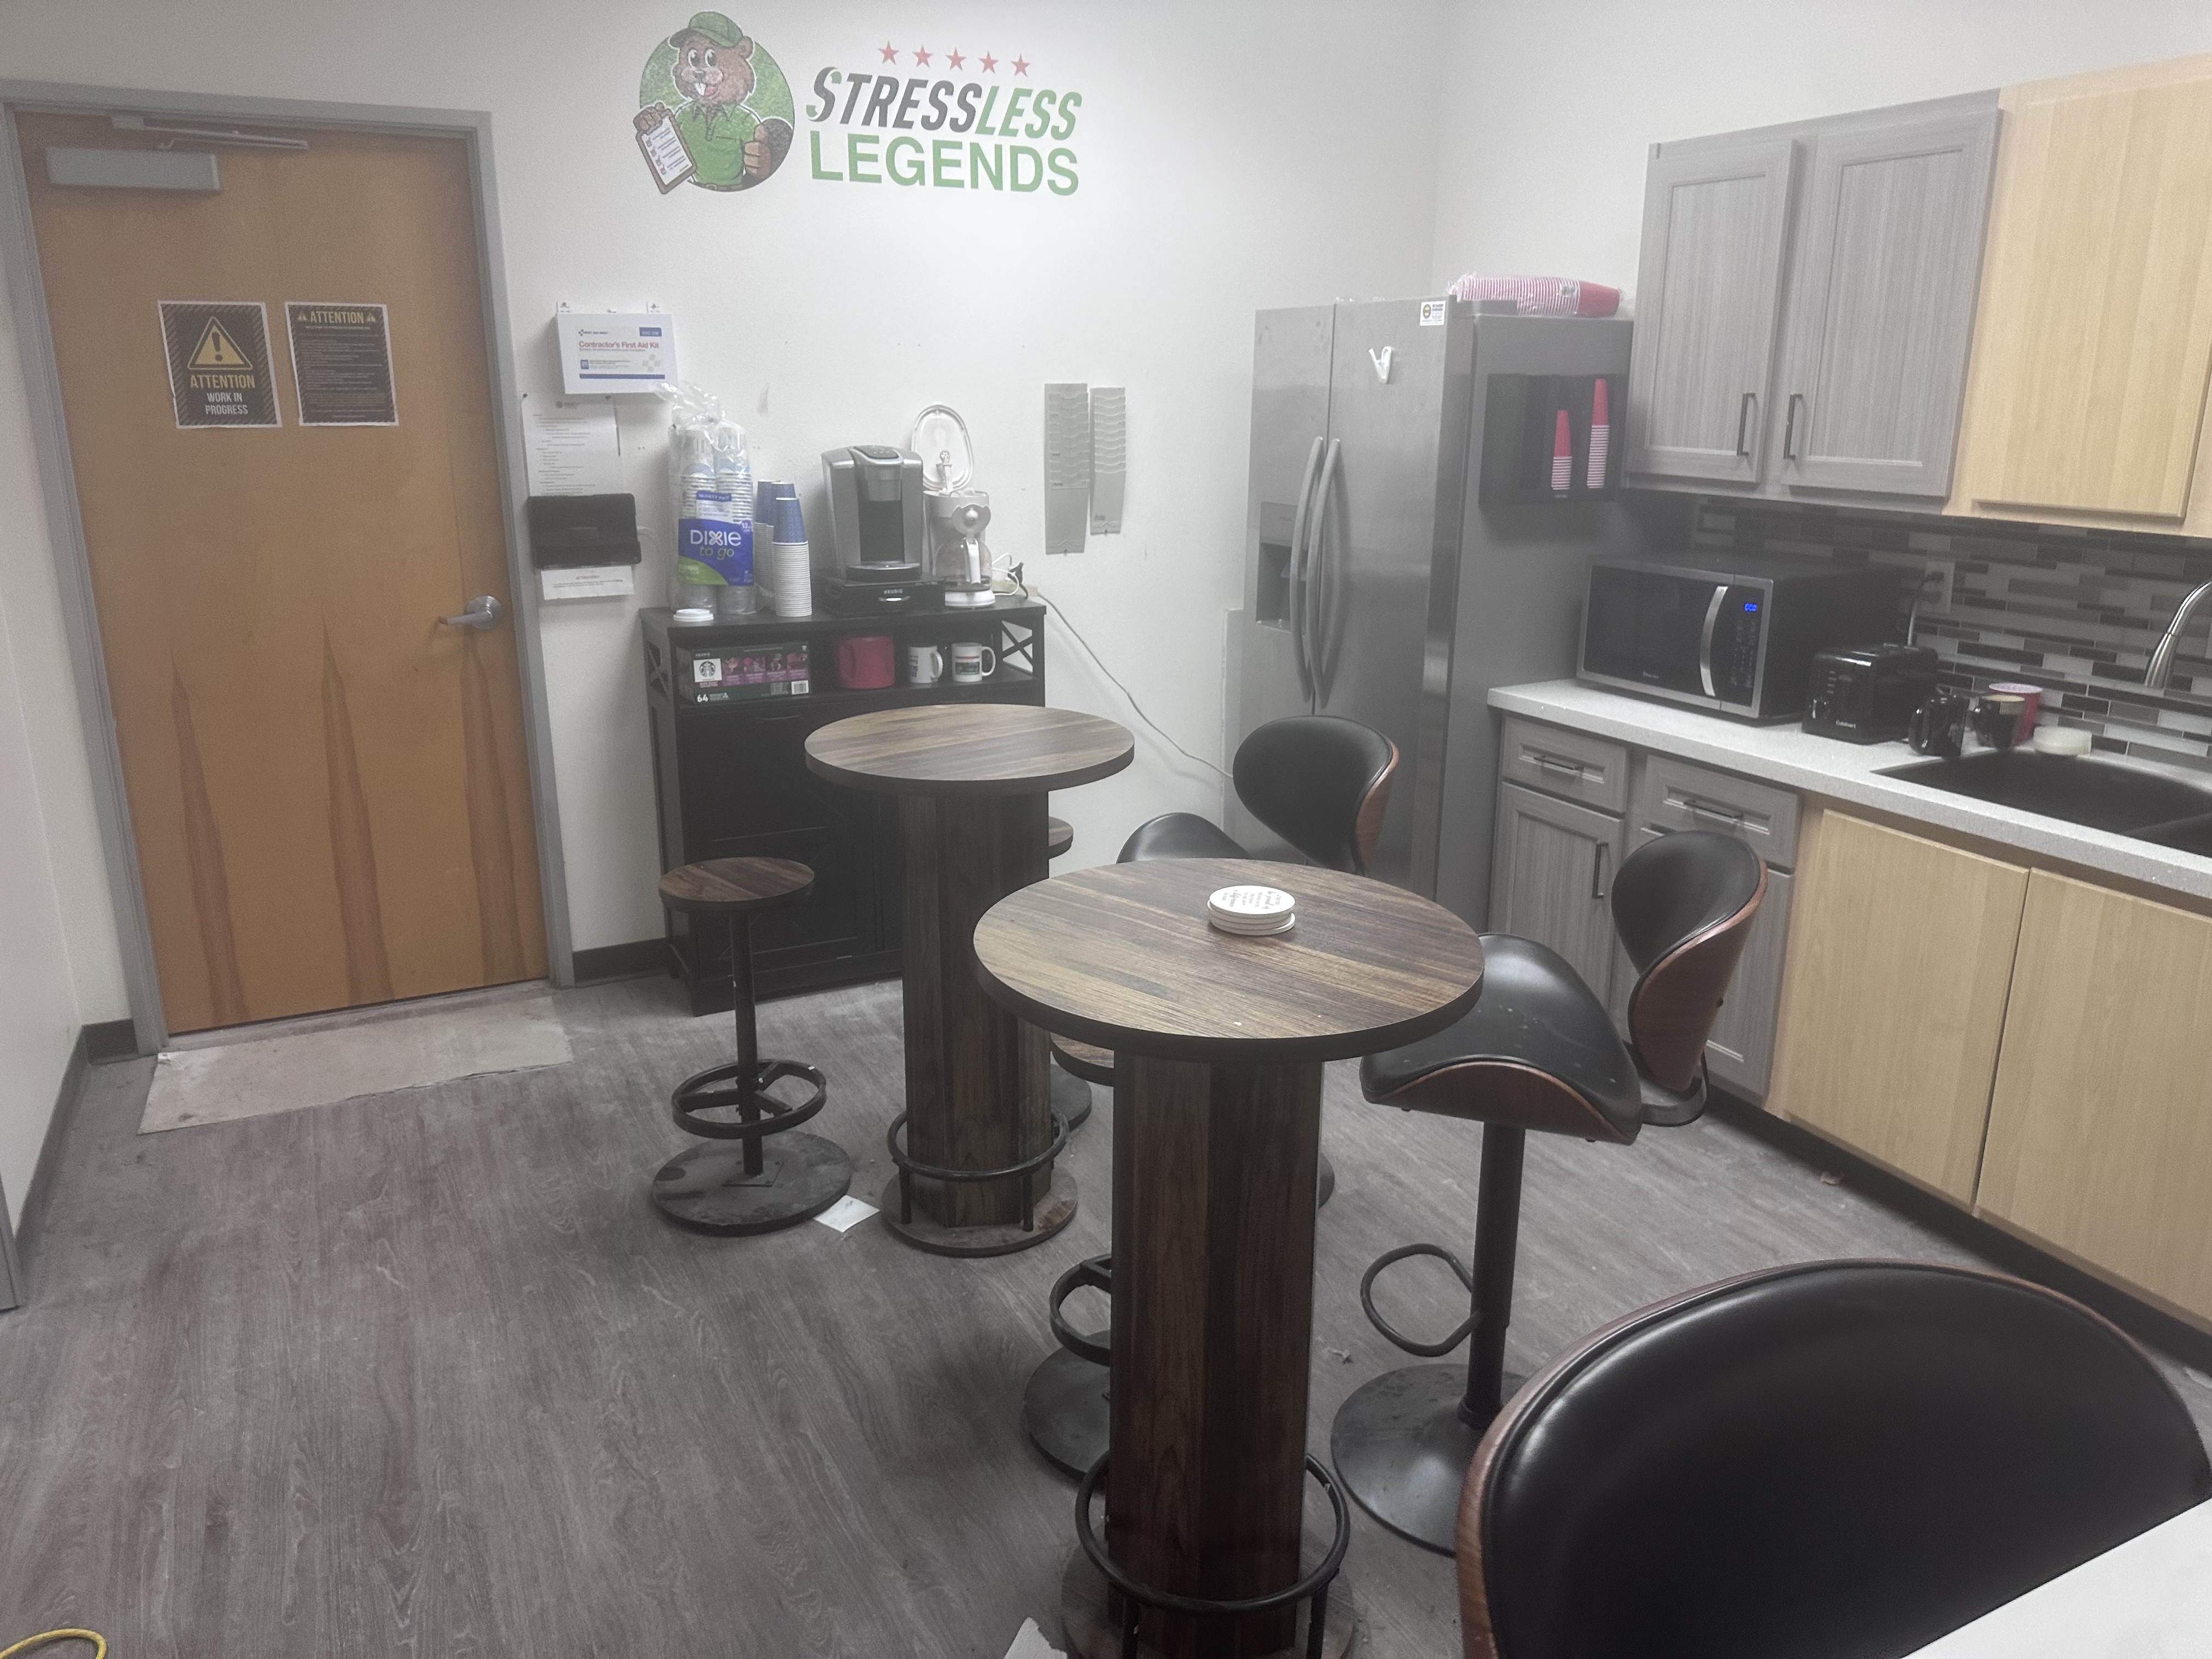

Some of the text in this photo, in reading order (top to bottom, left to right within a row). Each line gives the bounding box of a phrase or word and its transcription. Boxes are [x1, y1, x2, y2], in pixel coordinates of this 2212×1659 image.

[806, 67, 1082, 140] STRESSLESS
[810, 131, 1080, 196] LEGENDS
[310, 311, 364, 324] ATTENTION
[190, 375, 256, 389] ATTENTION
[206, 392, 243, 403] WORK IN
[205, 404, 249, 415] PROGRESS
[699, 545, 735, 560] to go
[697, 693, 709, 703] 64
